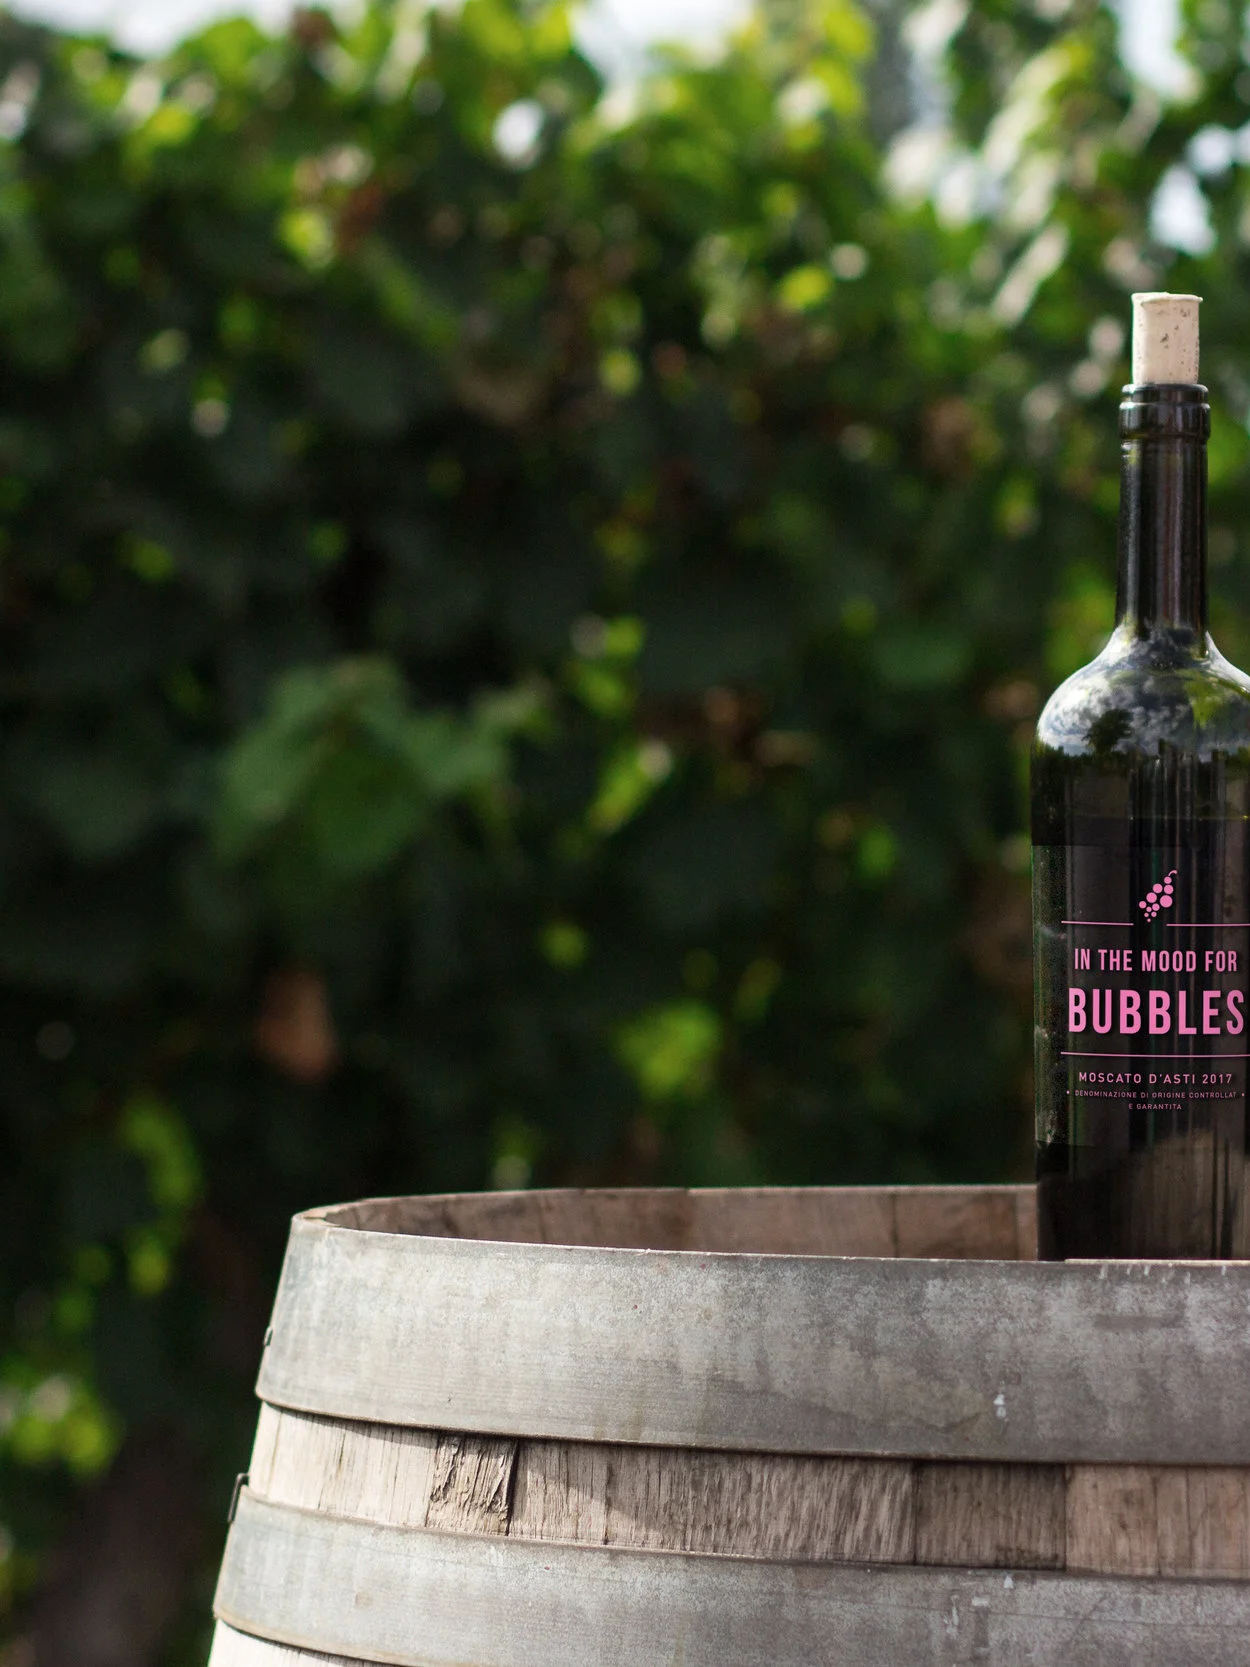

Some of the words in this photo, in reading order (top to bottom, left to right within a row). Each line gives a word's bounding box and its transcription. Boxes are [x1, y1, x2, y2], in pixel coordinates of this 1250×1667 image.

[1074, 948, 1091, 971] IN
[1098, 949, 1133, 972] THE
[1141, 950, 1197, 972] MOOD
[1205, 950, 1238, 972] FOR
[1068, 988, 1245, 1036] BUBBLES
[1079, 1072, 1142, 1084] MOSCATO
[1149, 1073, 1196, 1084] D'ASTI
[1202, 1073, 1233, 1084] 2017
[1074, 1090, 1137, 1099] DENOMINAZIONE
[1140, 1091, 1149, 1099] DI
[1152, 1091, 1186, 1099] ORIGINE
